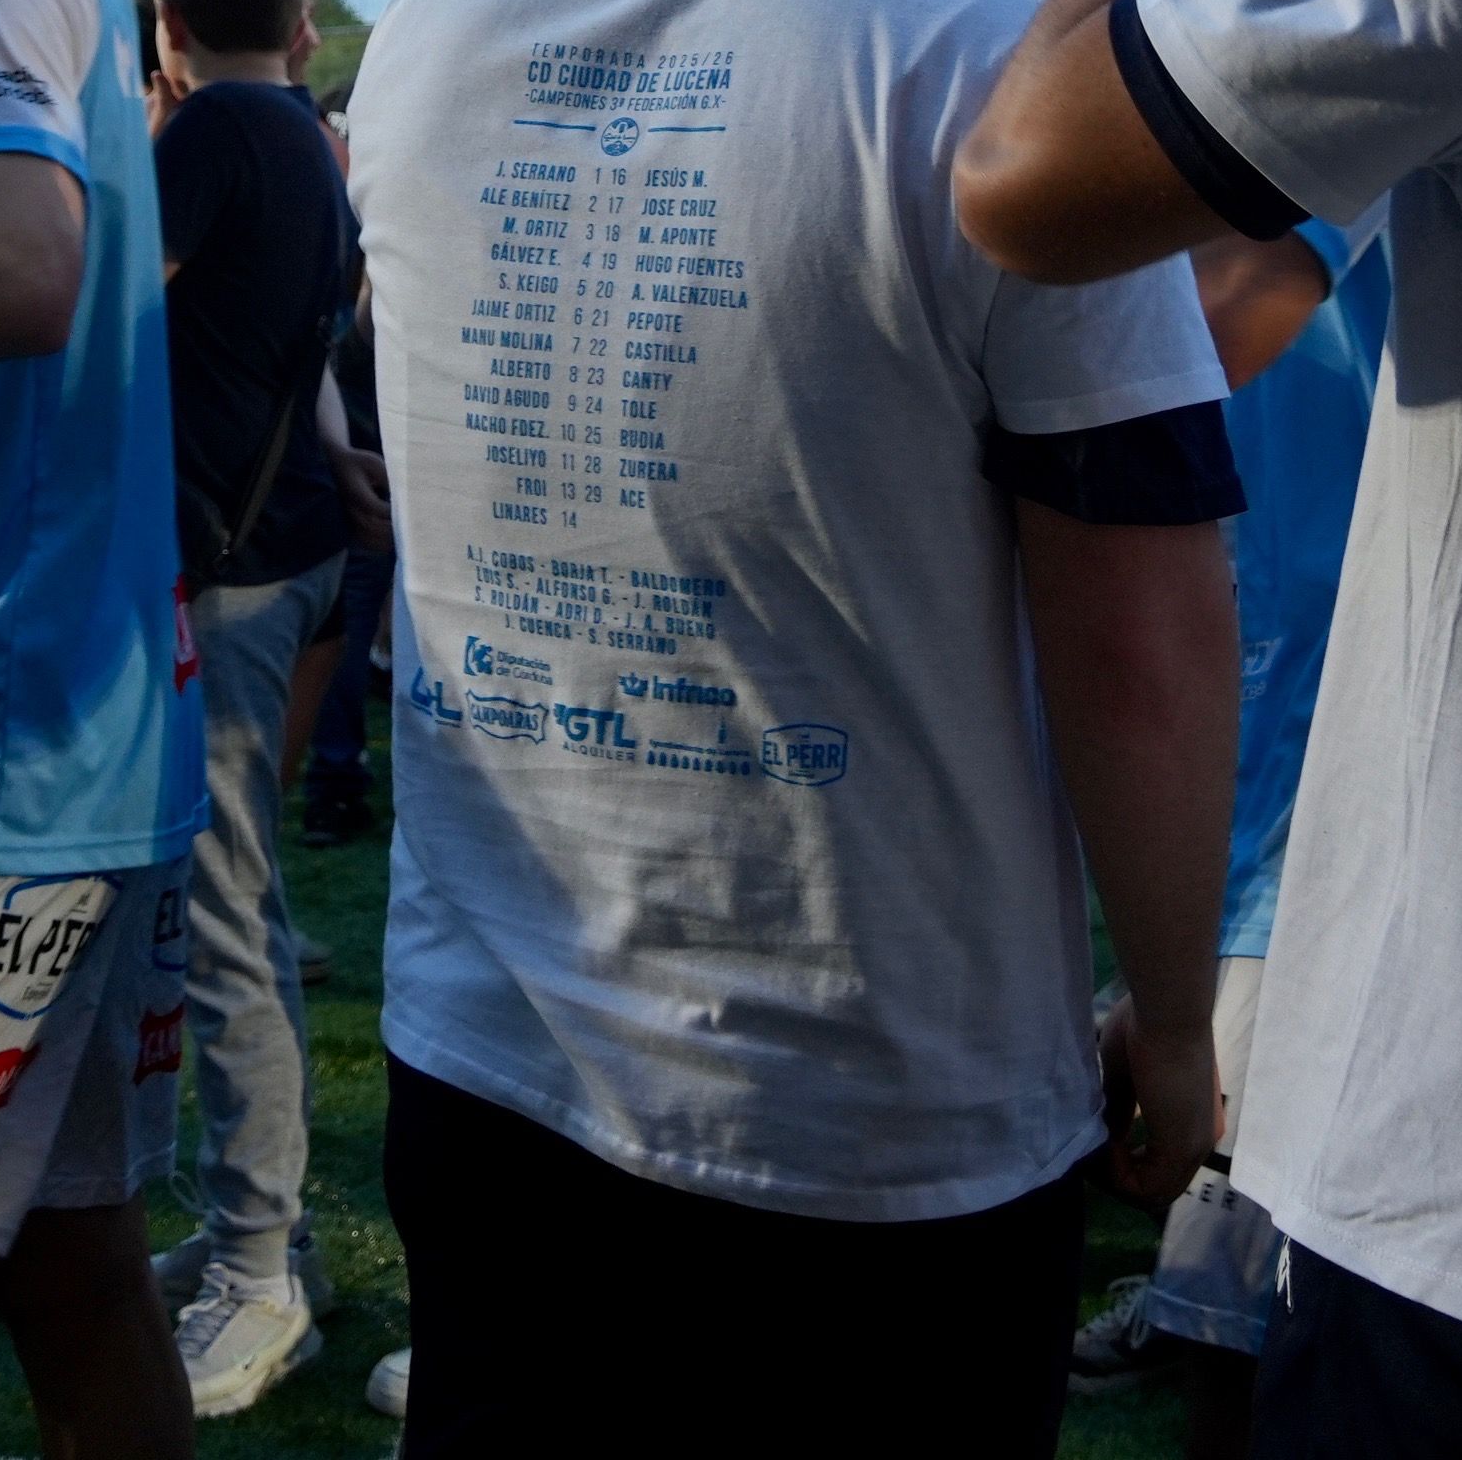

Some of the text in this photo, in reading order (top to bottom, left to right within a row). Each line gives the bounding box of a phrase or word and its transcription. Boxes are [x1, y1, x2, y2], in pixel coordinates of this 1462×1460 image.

[532, 42, 735, 70] TEMPORADA 2025/26
[527, 60, 732, 93] CD CIUDAD DE LUCENA
[627, 93, 697, 112] FEDERACIÓN
[496, 161, 708, 188] J. SERRANO 1 16 JESÚS M.
[480, 187, 716, 218] ALE BENÍTEZ 2 17 JOSE CRUZ
[503, 217, 717, 247] M. ORTIZ 3 18 M. APONTE
[490, 241, 744, 279] GÁLVEZ E. 4 19 HUGO FUENTES
[499, 273, 748, 309] S. KEIGO 5 20 A. VALENZUELA
[471, 299, 683, 333] JAIME ORTIZ 6 21 PEPOTE
[500, 331, 553, 351] MOLINA
[571, 337, 580, 354] 7
[589, 339, 607, 357] 22
[625, 341, 697, 365] CASTILLA
[490, 358, 674, 391] ALBERTO 8 23 CANTY
[464, 384, 657, 420] DAVID AGUDO 9 24 TOLE
[465, 412, 507, 435] NACHO
[561, 423, 576, 442] 10
[584, 426, 602, 445] 25
[619, 428, 665, 450] BUDIA
[562, 452, 575, 472] 11
[584, 455, 602, 474] 28
[619, 458, 678, 482] ZURERA
[516, 477, 646, 509] FROI 13 29 ACE
[492, 501, 577, 529] LINARES 14
[491, 550, 535, 574] COBOS
[551, 559, 595, 582] BORJA
[476, 565, 501, 588] LUIS
[536, 577, 597, 603] ALFONSO
[555, 601, 587, 623] ADRI
[519, 617, 572, 640] CUENCA
[607, 631, 677, 656] SERRANO
[564, 707, 636, 749] GTL
[563, 741, 636, 762] ALQUILER
